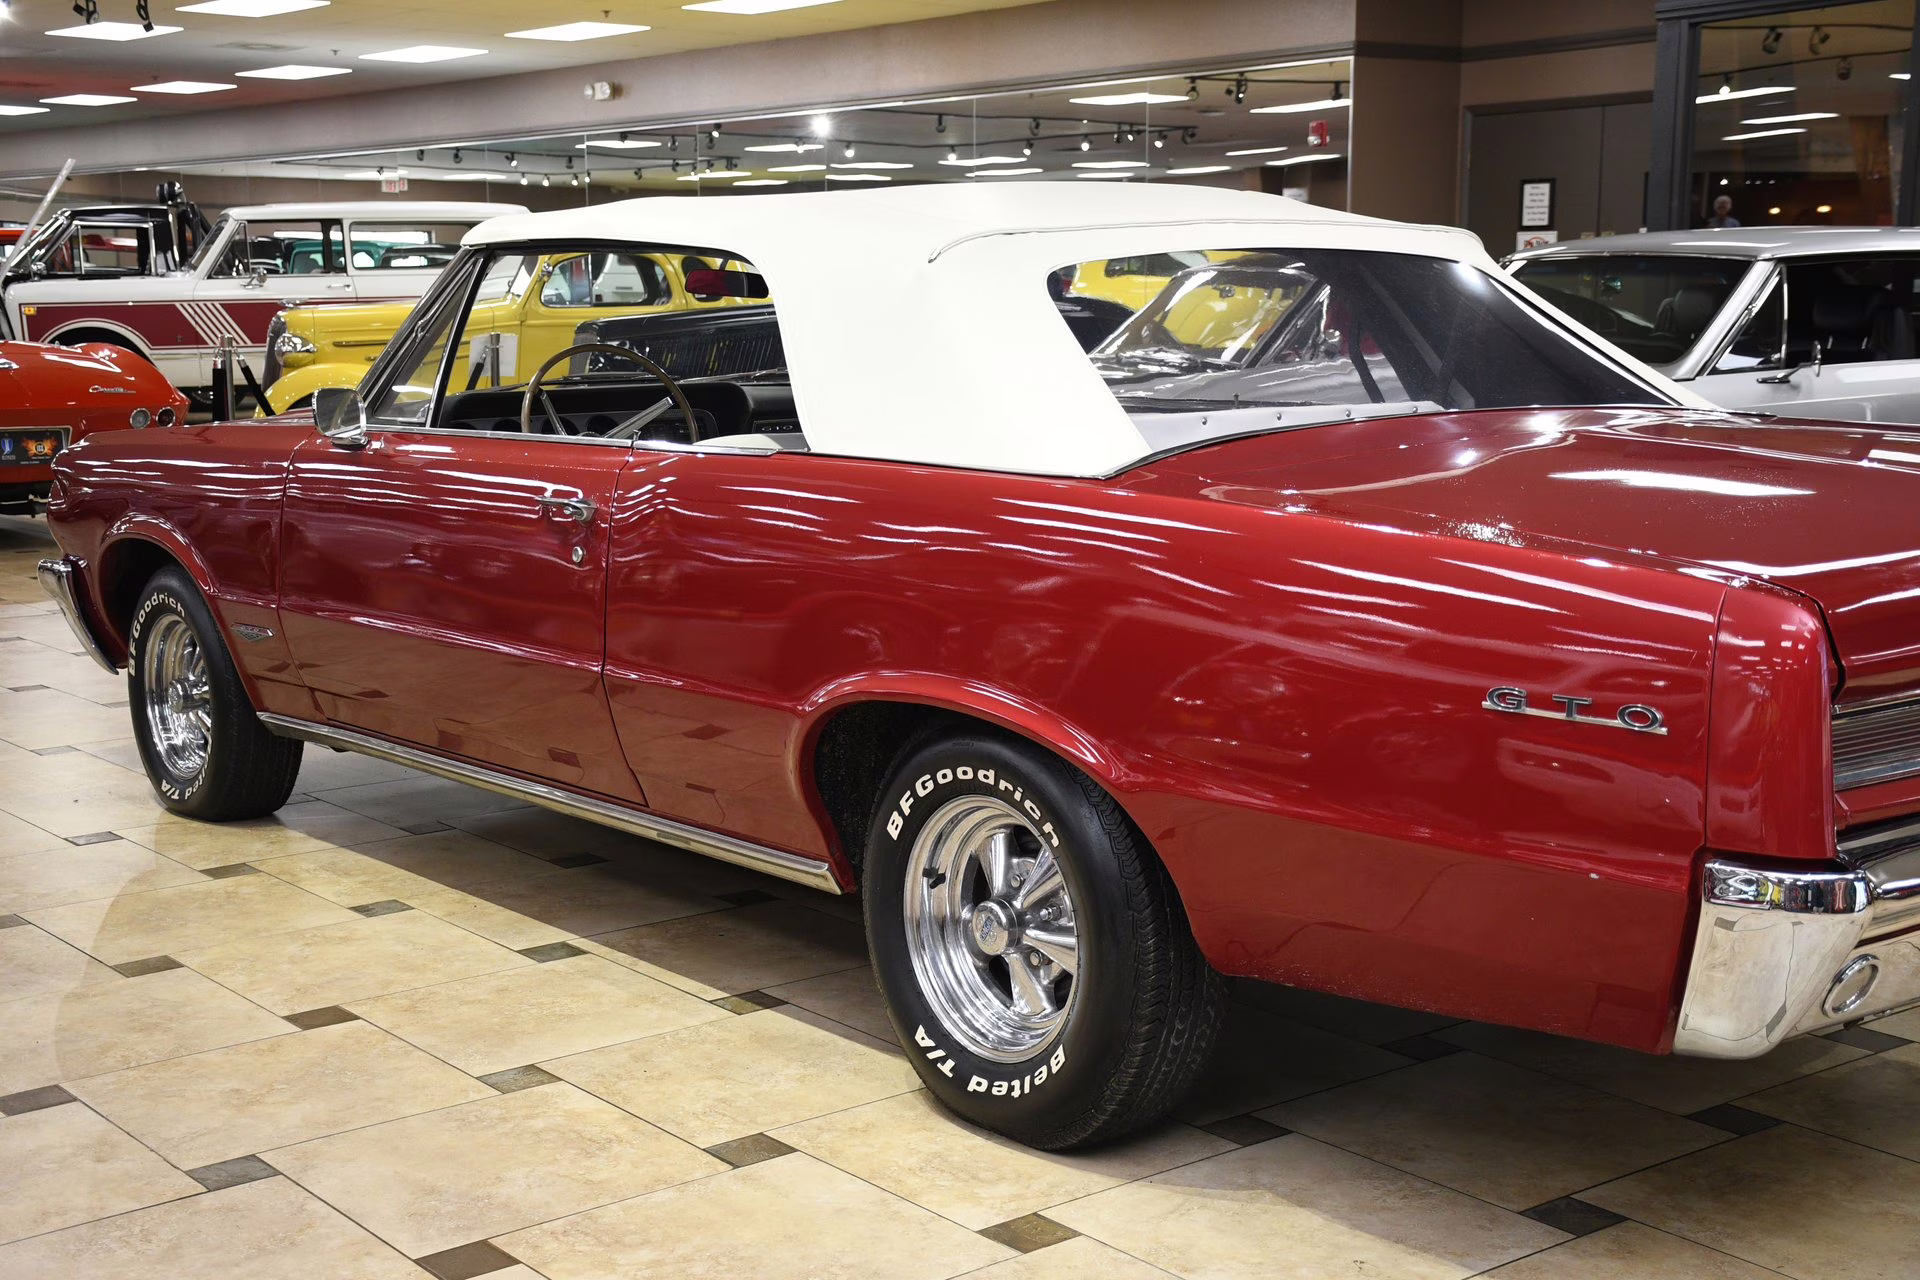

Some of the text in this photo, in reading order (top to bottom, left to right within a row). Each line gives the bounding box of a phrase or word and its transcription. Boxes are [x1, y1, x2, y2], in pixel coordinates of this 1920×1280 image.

[128, 592, 185, 677] BFGoodrich
[1486, 686, 1663, 731] GTO
[161, 779, 180, 800] T/A
[887, 766, 1060, 848] BFGoodrich
[914, 1024, 1066, 1098] Belted T/A
